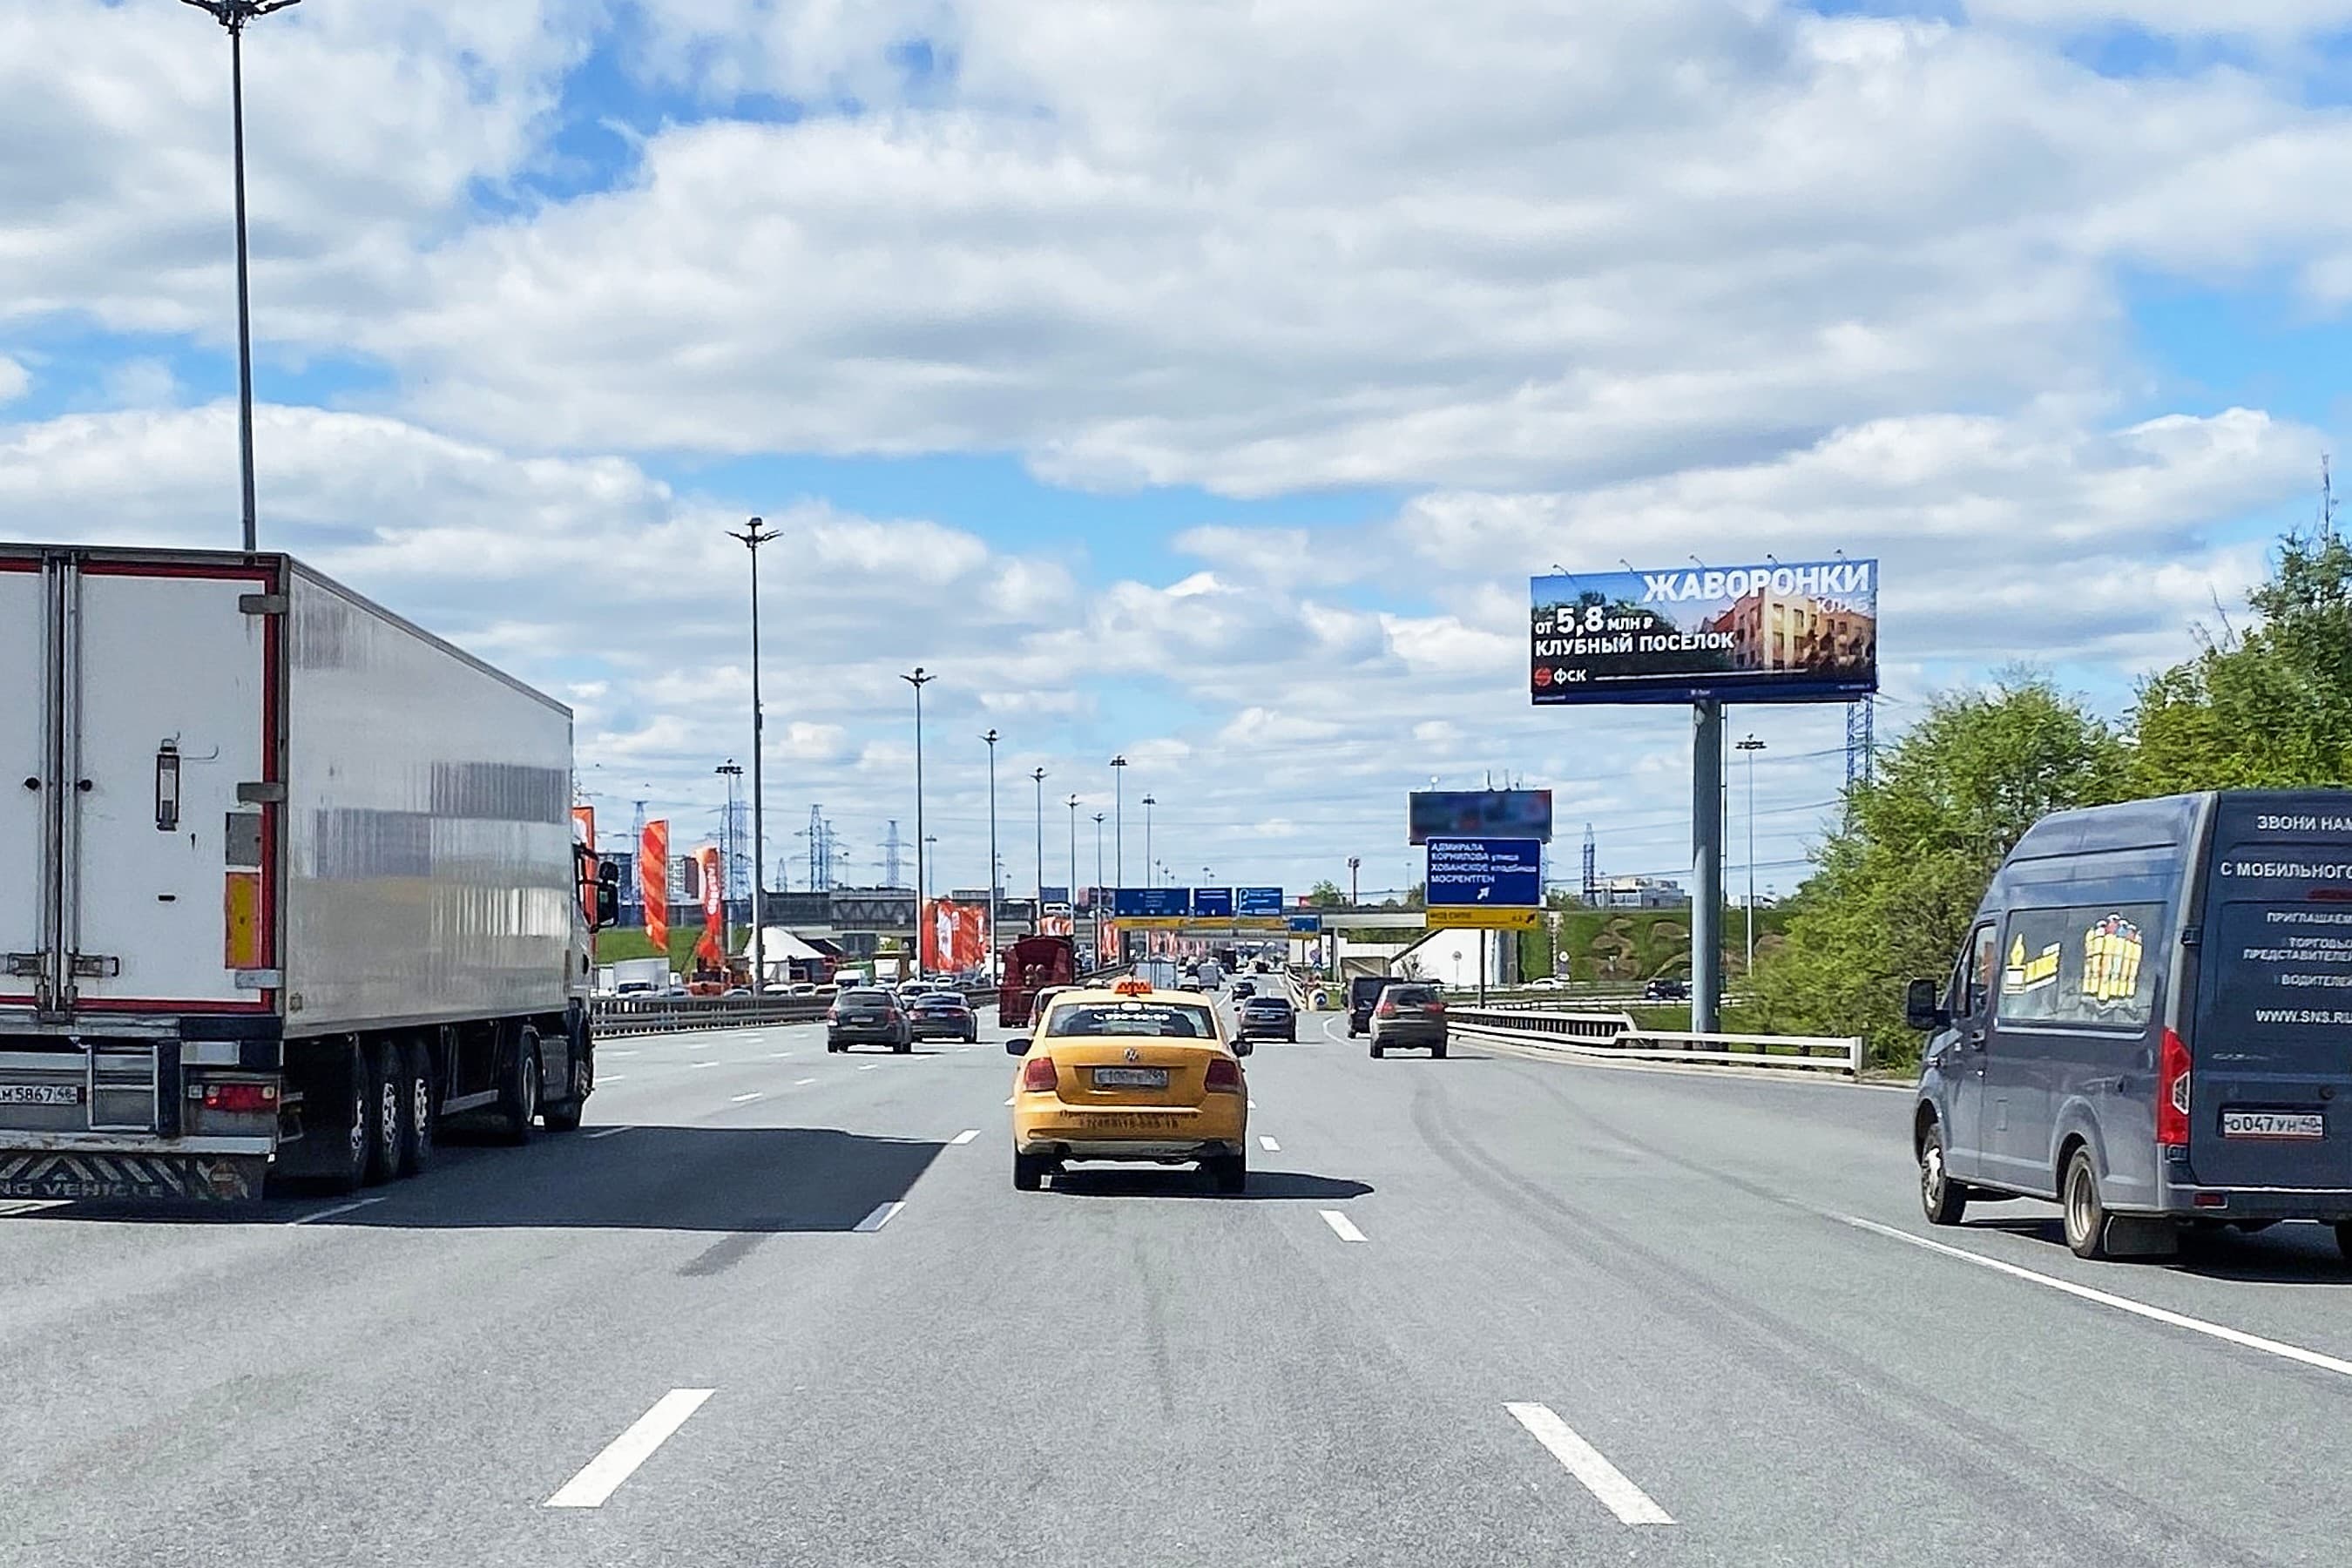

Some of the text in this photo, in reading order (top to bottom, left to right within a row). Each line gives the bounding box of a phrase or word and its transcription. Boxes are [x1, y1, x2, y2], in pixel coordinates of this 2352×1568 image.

[1643, 564, 1869, 602] ЖАВОРОНКИ
[1557, 605, 1604, 637] 5,8
[1536, 632, 1633, 657] КЛУБНЫЙ
[1553, 667, 1587, 685] ФСК
[2257, 814, 2316, 830] ЗВОНИ
[2220, 862, 2232, 876] С
[1431, 875, 1495, 883] МОСРЕНТГЕН
[2255, 1010, 2352, 1024] WWW.SNS.RU
[44, 1182, 164, 1198] VEHICLE
